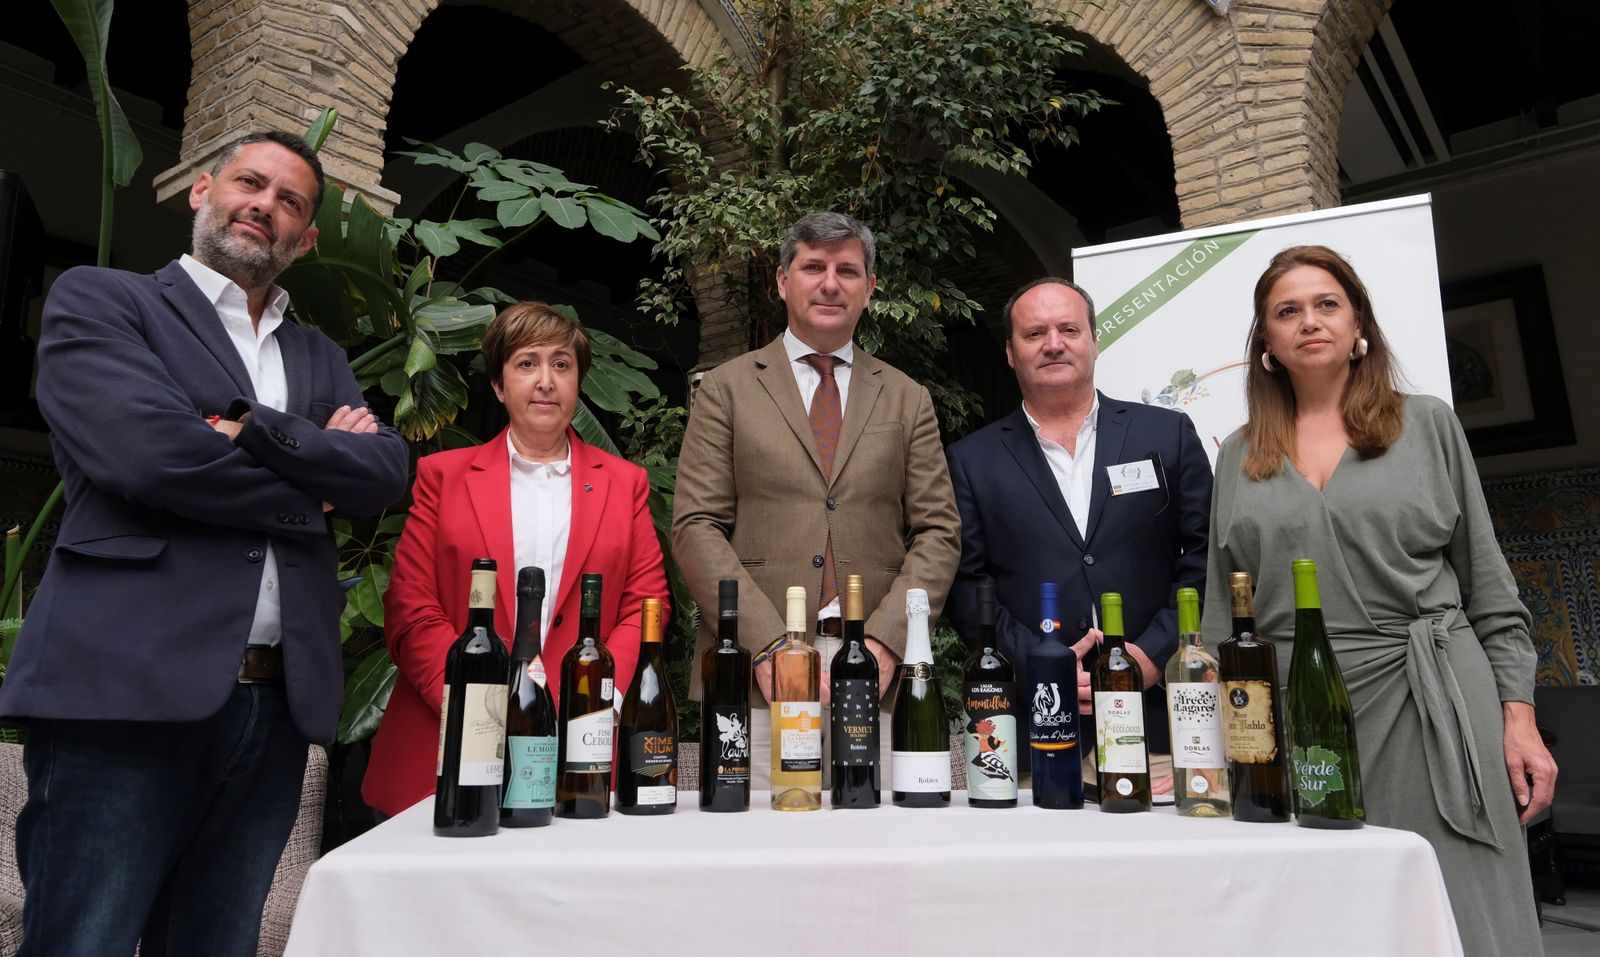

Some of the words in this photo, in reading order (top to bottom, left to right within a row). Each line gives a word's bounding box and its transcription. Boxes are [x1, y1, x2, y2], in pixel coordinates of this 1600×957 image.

[1096, 239, 1220, 341] PRESENTACIÓN
[843, 725, 873, 734] VERMUT
[1294, 760, 1334, 776] Verde
[1300, 776, 1327, 791] Sur
